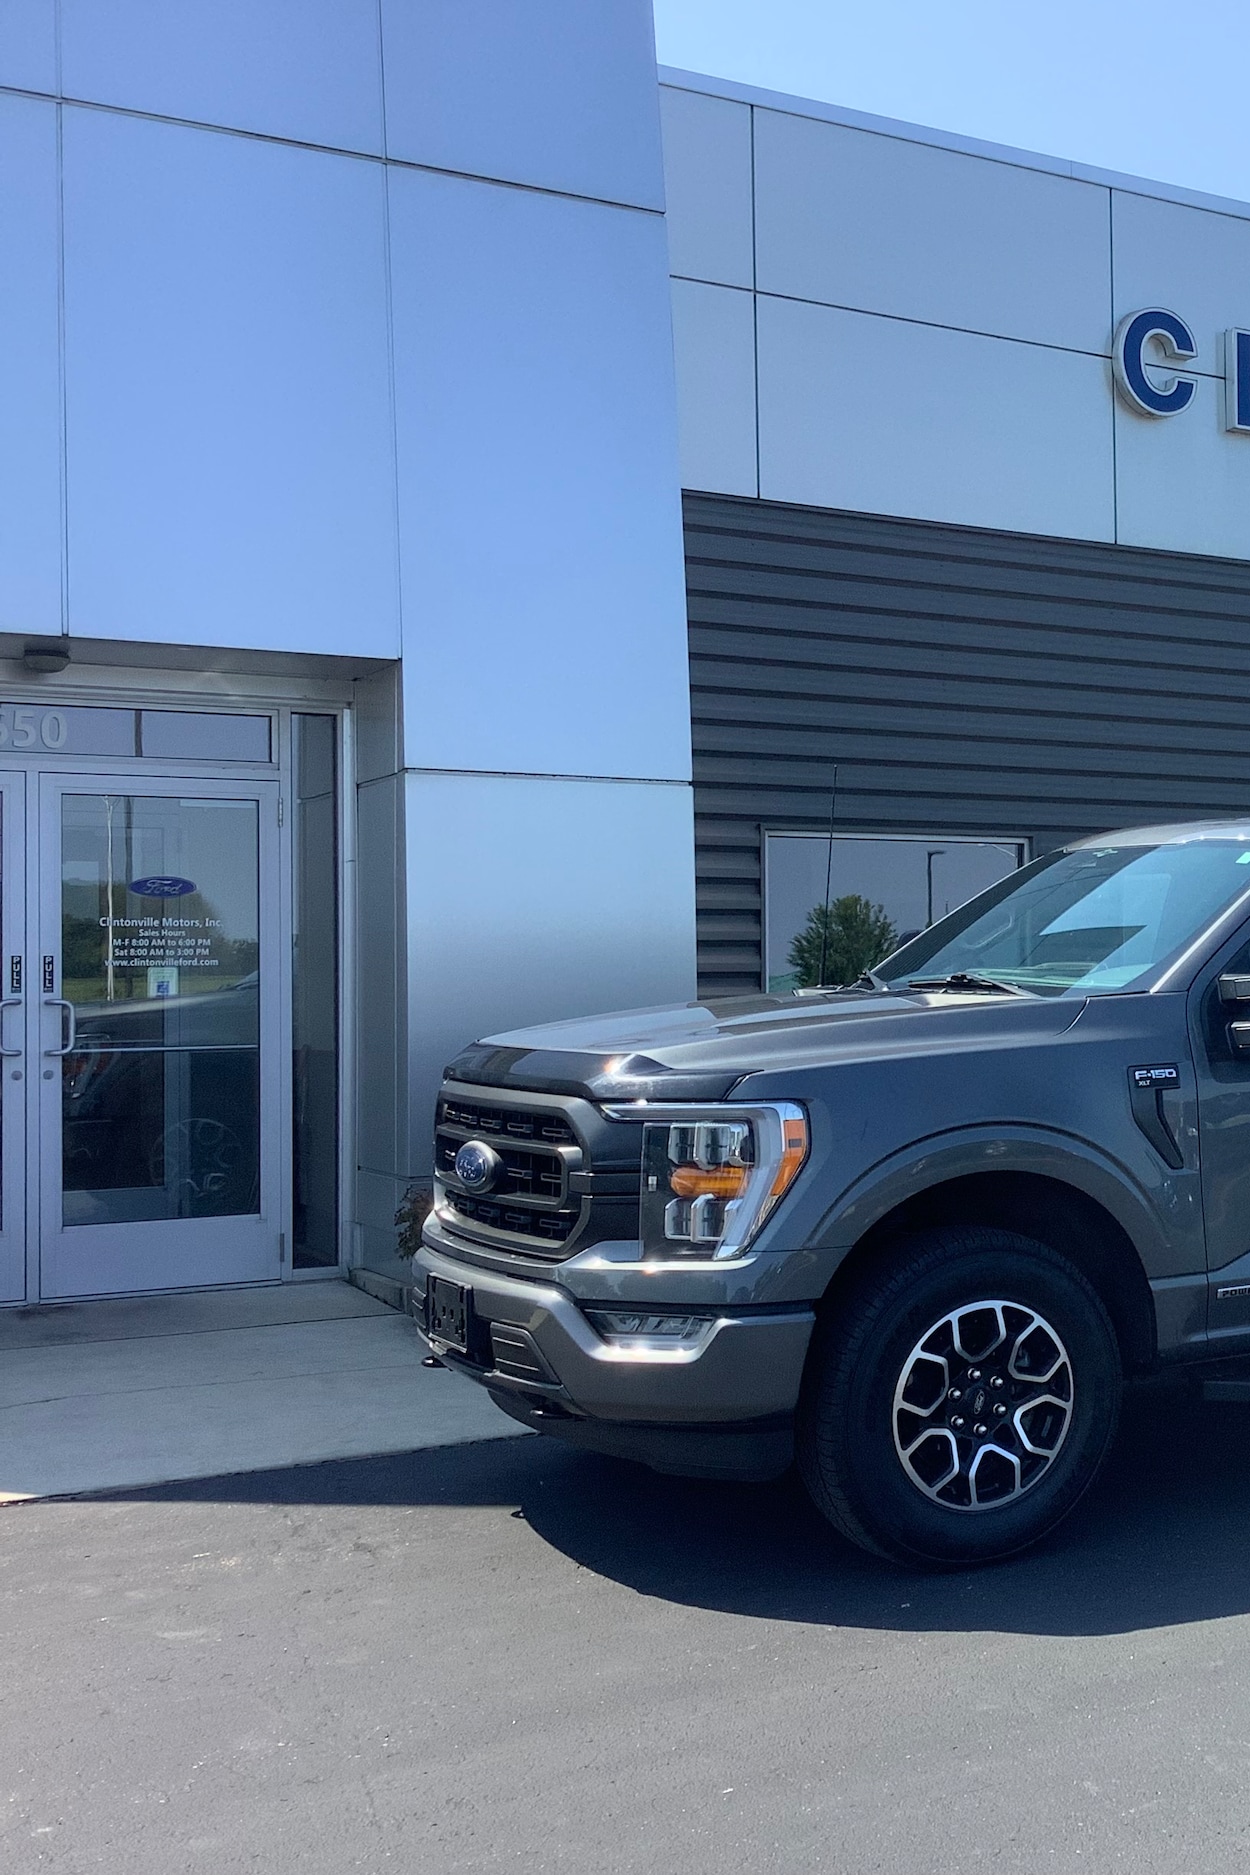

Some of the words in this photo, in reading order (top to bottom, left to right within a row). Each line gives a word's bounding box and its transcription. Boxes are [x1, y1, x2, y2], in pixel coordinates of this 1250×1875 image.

[99, 916, 160, 927] Clintonville
[162, 917, 202, 929] Motors,
[138, 928, 160, 937] Sales
[161, 929, 186, 937] Hours
[112, 938, 130, 947] M-F
[131, 938, 149, 947] 8:00
[151, 938, 166, 947] AM
[167, 939, 177, 947] to
[178, 938, 196, 947] 6:00
[197, 938, 211, 946] PM
[114, 948, 128, 957] Sat
[129, 948, 148, 956] 8:00
[149, 948, 164, 956] AM
[177, 948, 194, 956] 3:00
[195, 948, 210, 956] PM
[104, 957, 219, 967] www.clintonvilleford.com
[12, 956, 21, 988] PULL
[44, 956, 53, 988] PULL
[1134, 1068, 1177, 1080] F-150
